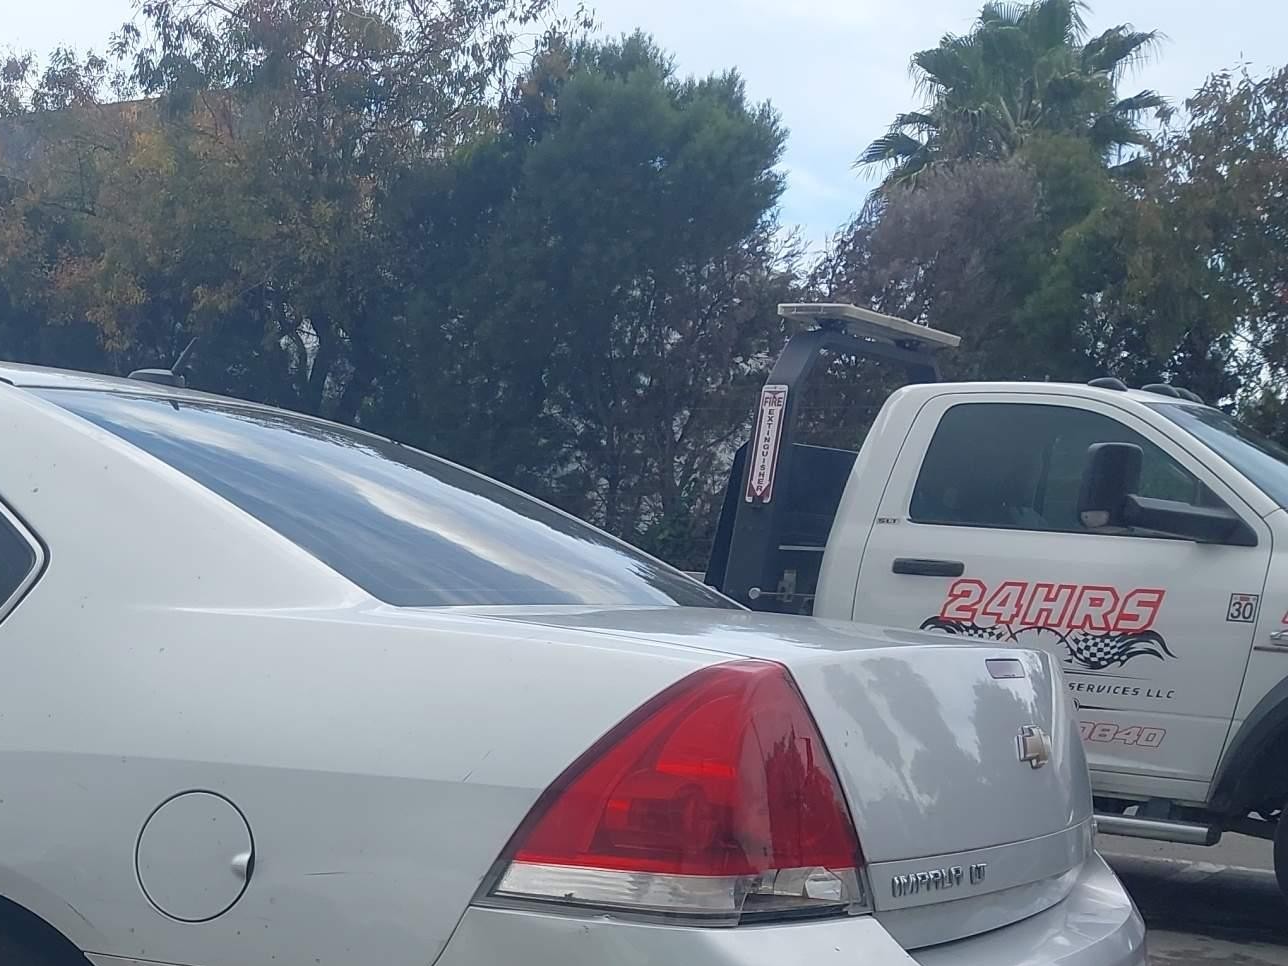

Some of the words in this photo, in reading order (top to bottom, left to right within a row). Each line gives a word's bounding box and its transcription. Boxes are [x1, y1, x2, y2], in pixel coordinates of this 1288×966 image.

[763, 396, 783, 407] FIRE
[755, 408, 775, 492] EXTINGUISHER
[940, 578, 1166, 635] 24HRS
[1230, 601, 1254, 620] 30
[1068, 682, 1140, 696] SERVICES
[1146, 688, 1175, 699] LLC
